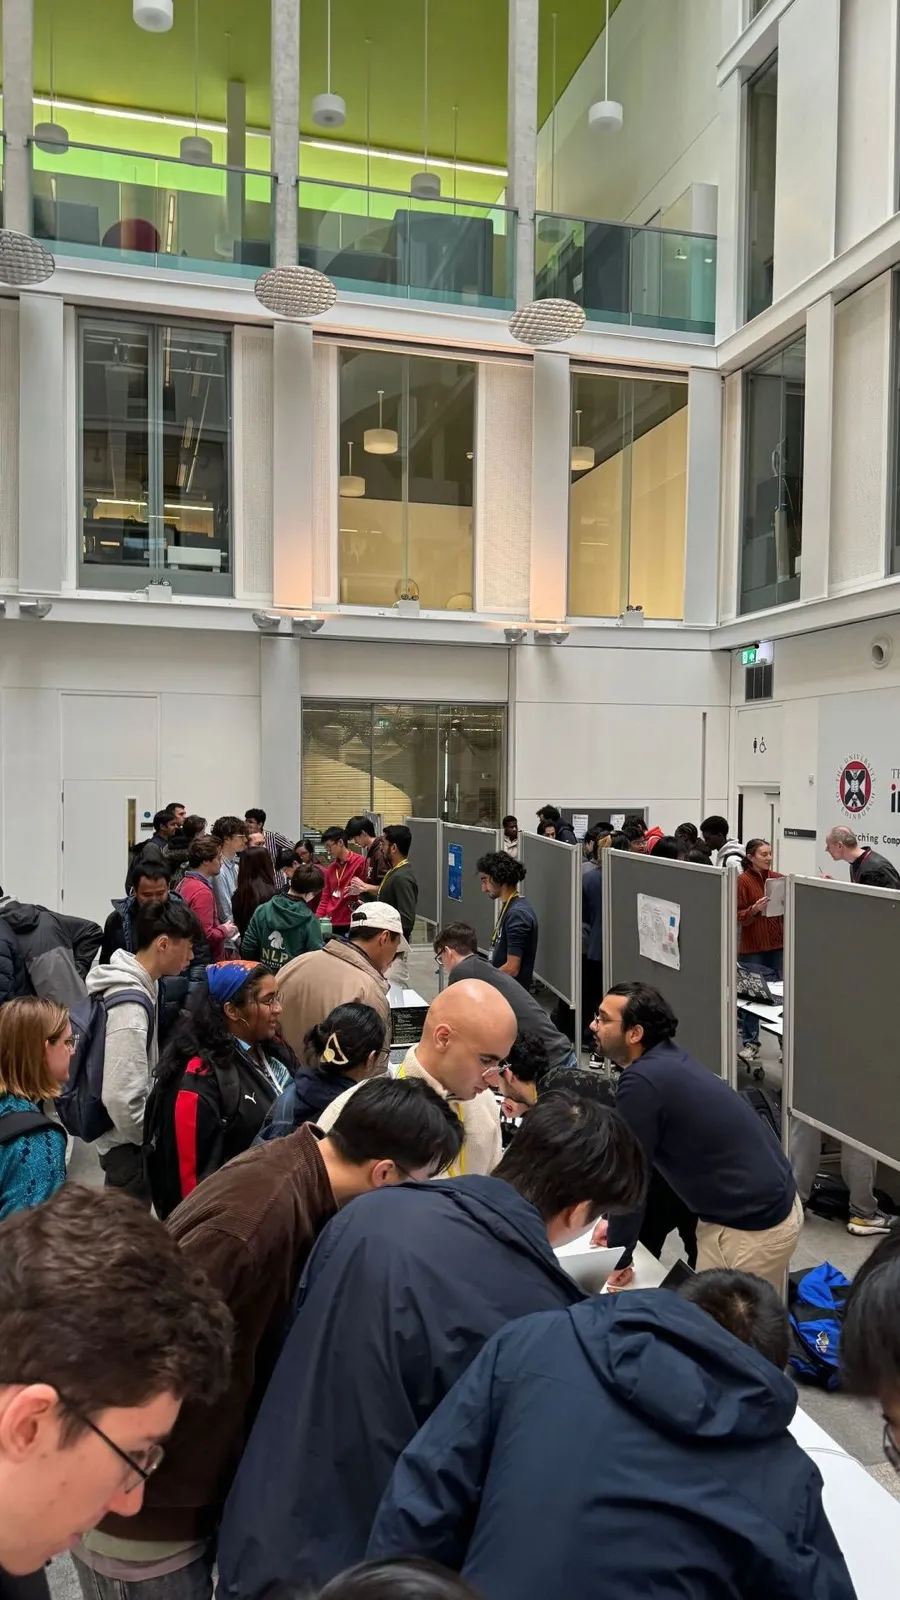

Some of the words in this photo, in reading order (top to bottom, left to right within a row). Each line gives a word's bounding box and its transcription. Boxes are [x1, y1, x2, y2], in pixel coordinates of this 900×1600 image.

[844, 754, 876, 783] UNIVERSITY
[841, 793, 876, 820] EDINBURGH
[262, 948, 288, 963] NLP
